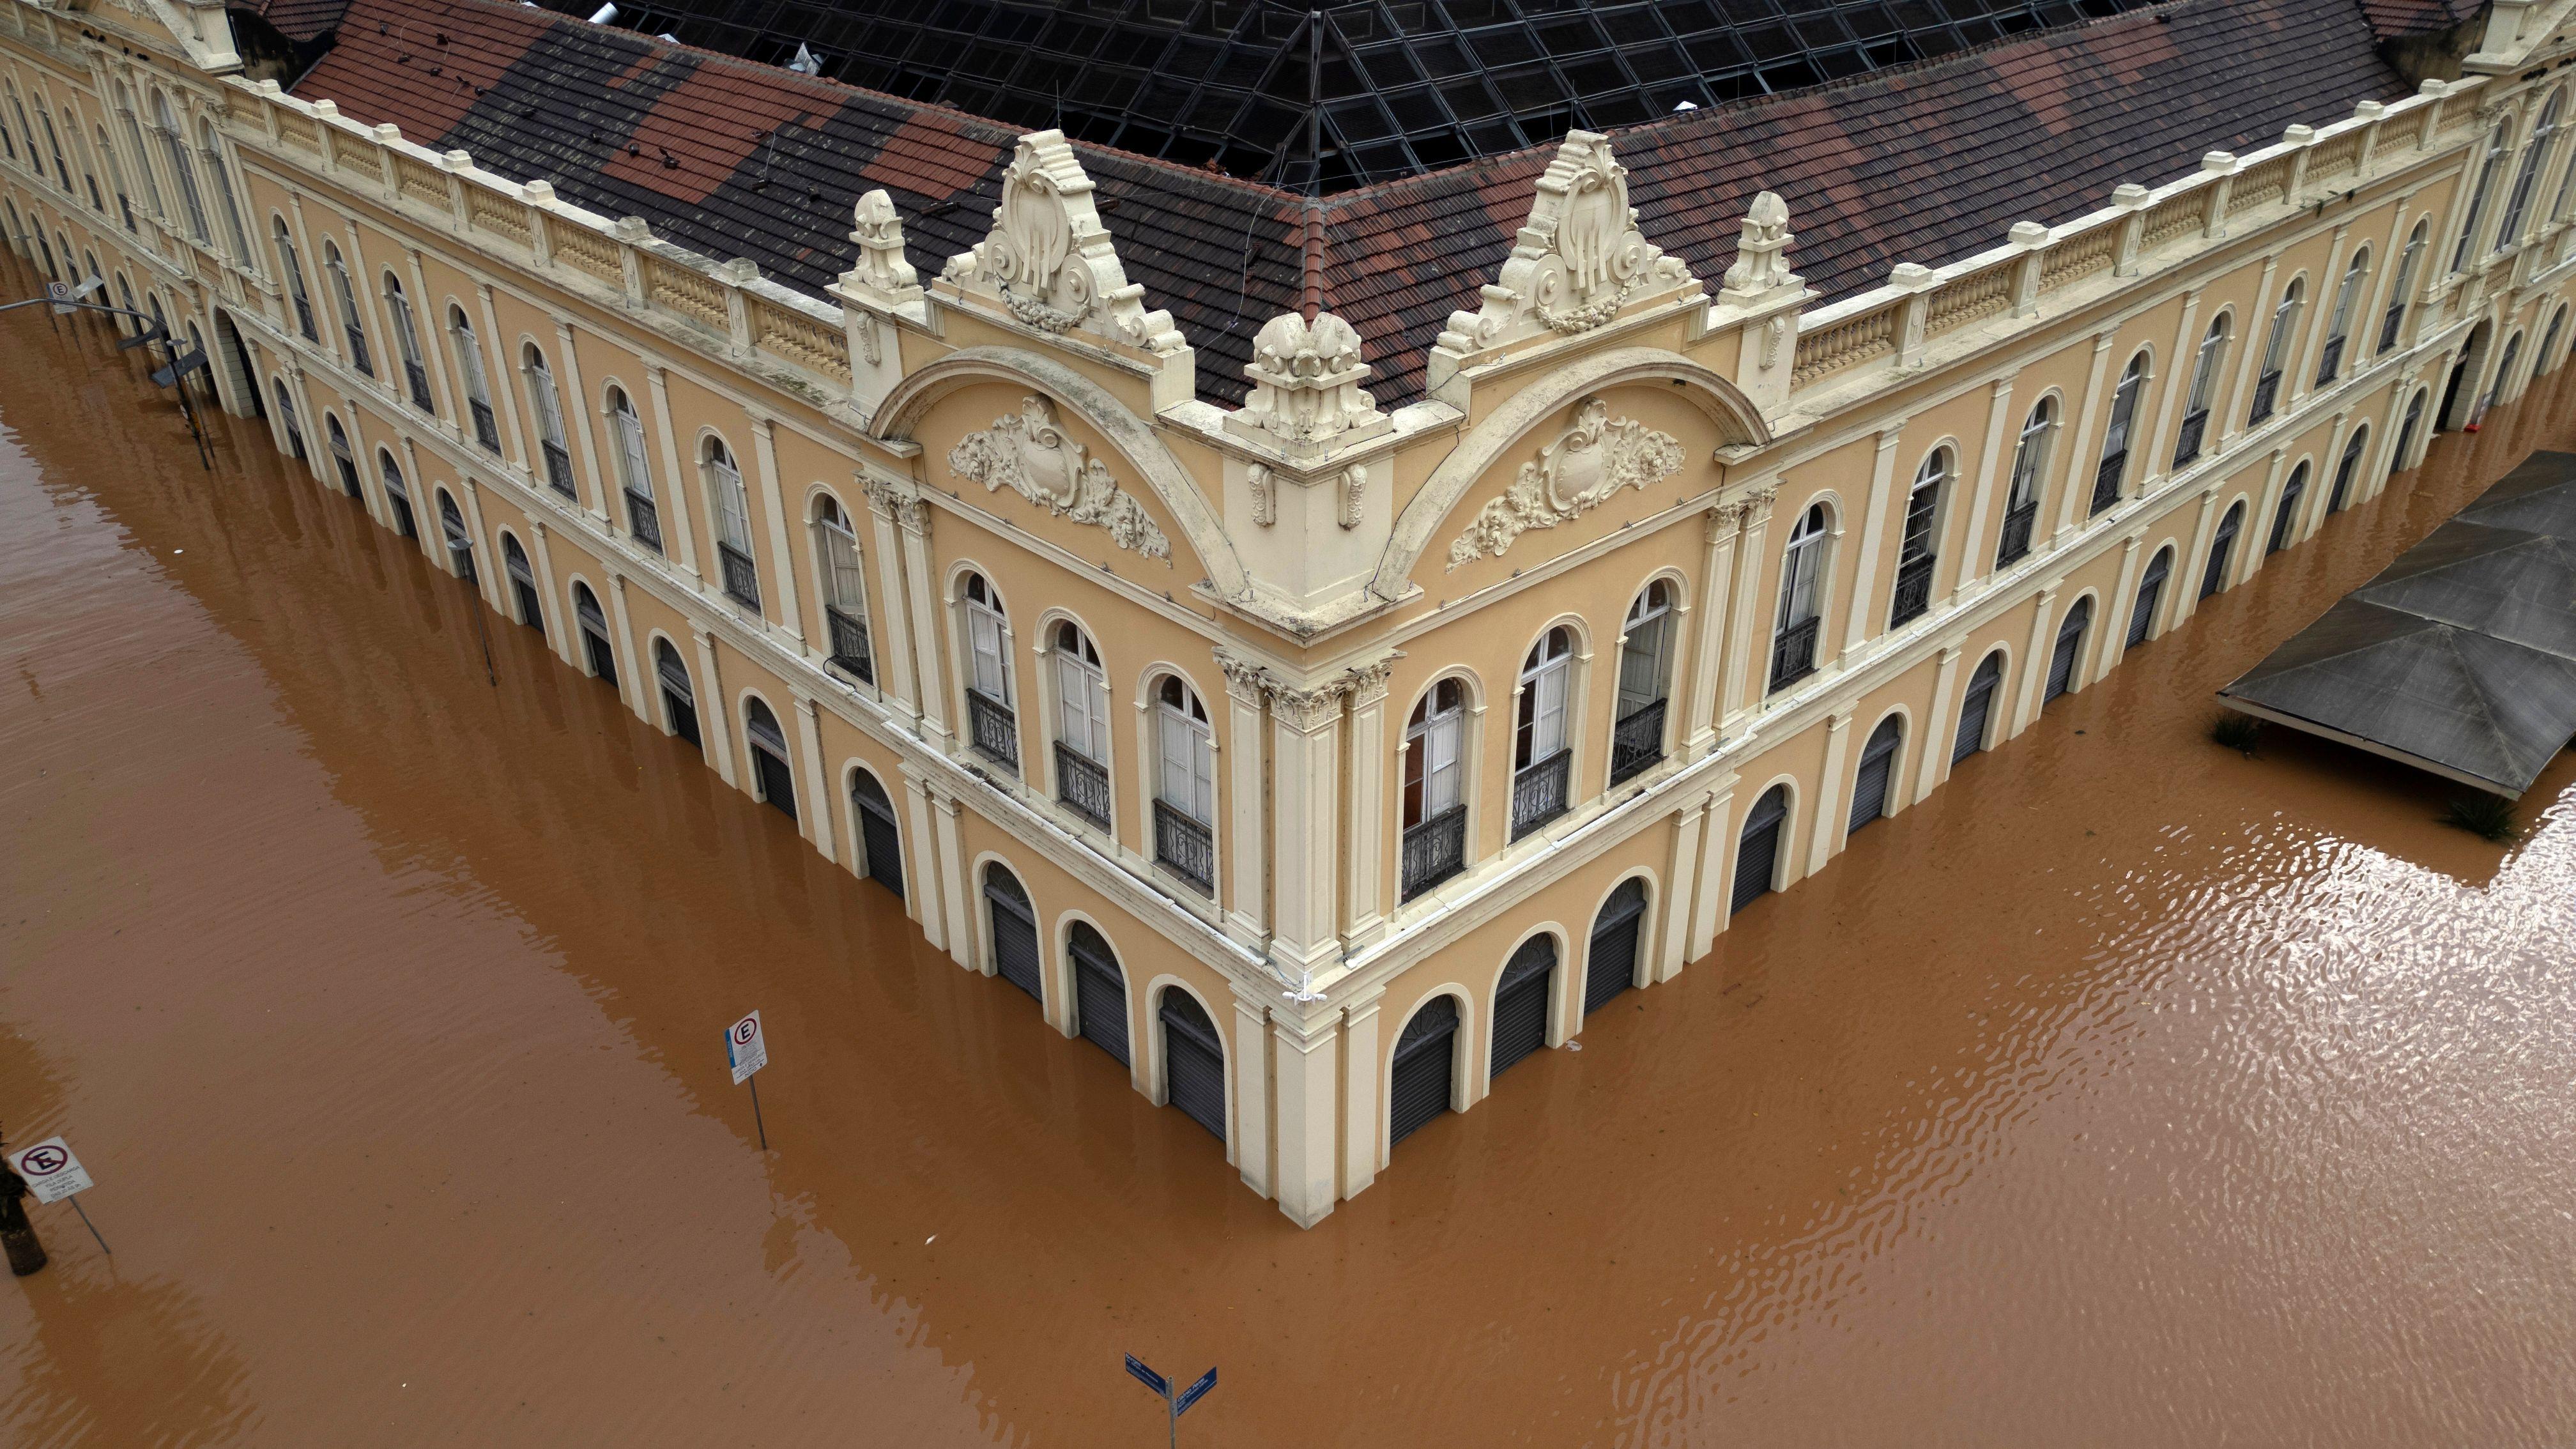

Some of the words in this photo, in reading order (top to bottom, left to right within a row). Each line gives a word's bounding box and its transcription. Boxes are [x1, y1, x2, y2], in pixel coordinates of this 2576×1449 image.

[57, 286, 65, 294] E
[741, 1023, 751, 1040] E
[33, 1151, 57, 1170] E
